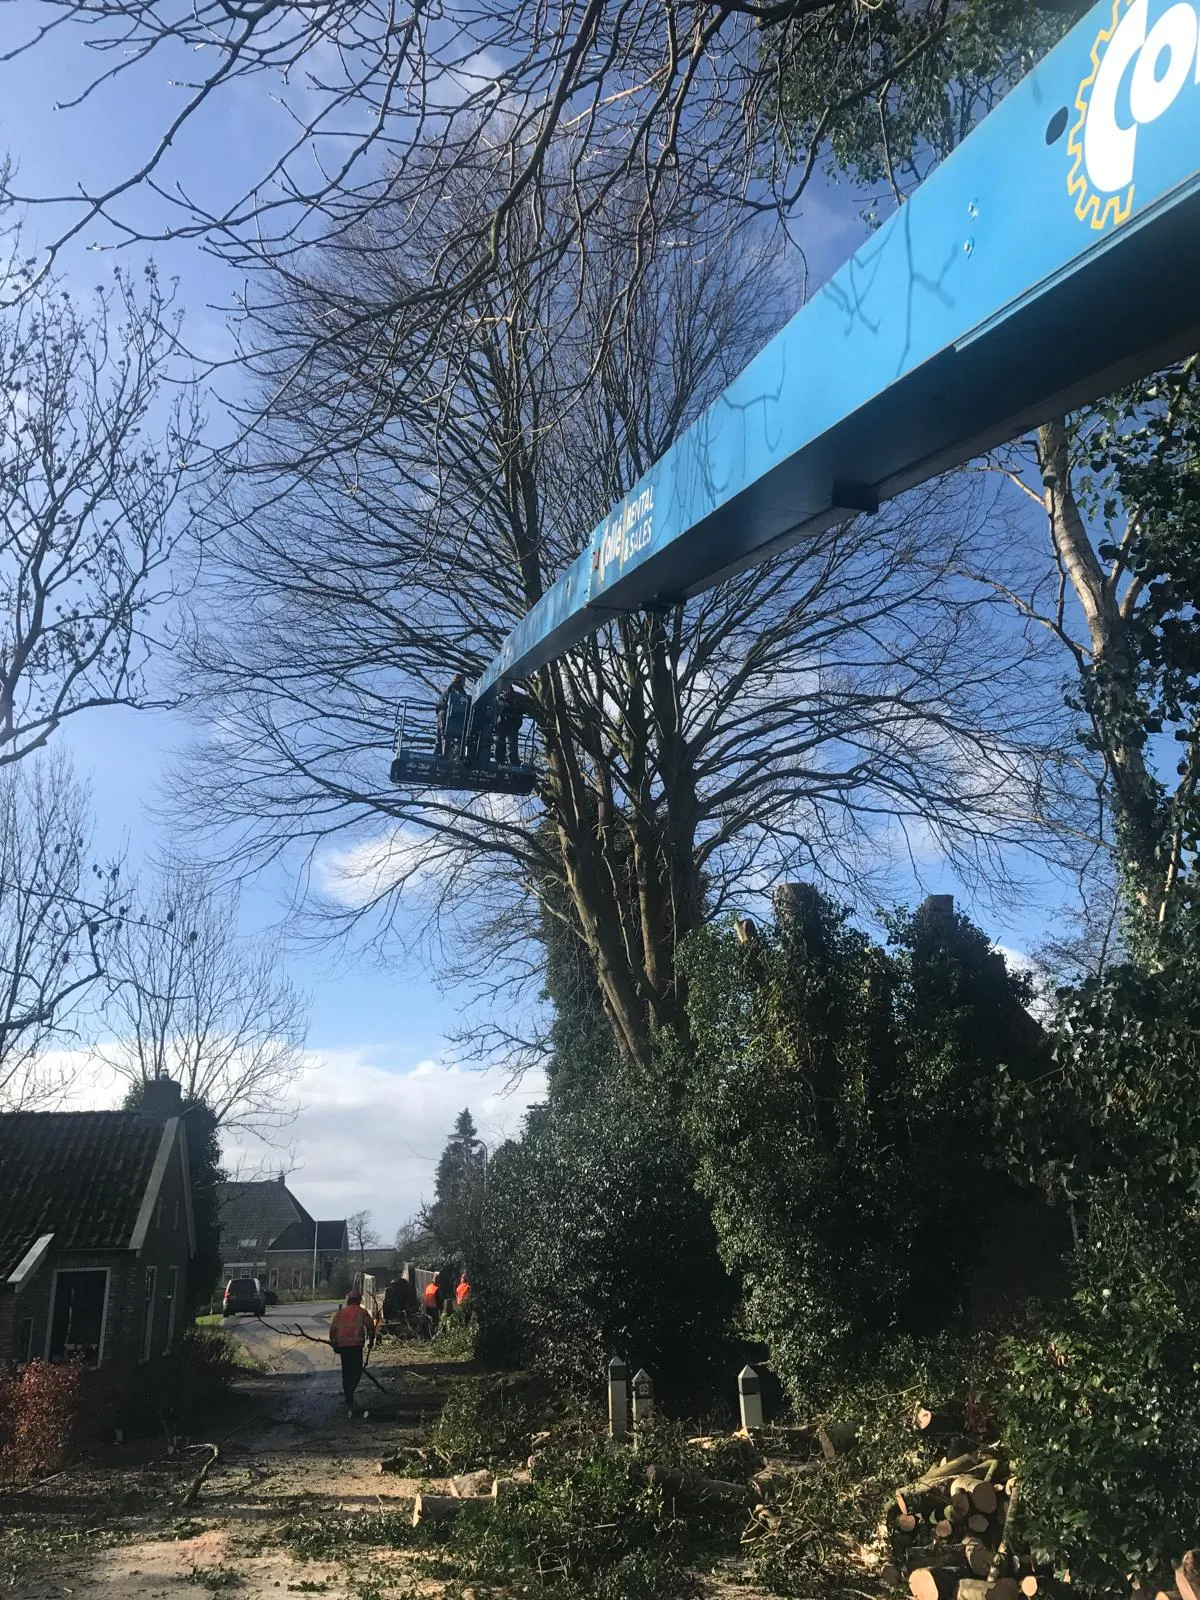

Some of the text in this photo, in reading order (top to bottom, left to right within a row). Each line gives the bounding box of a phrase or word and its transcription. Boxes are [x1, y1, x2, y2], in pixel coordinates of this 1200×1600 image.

[1084, 0, 1200, 192] Co
[626, 484, 654, 530] RENTAL
[629, 516, 653, 557] SALES
